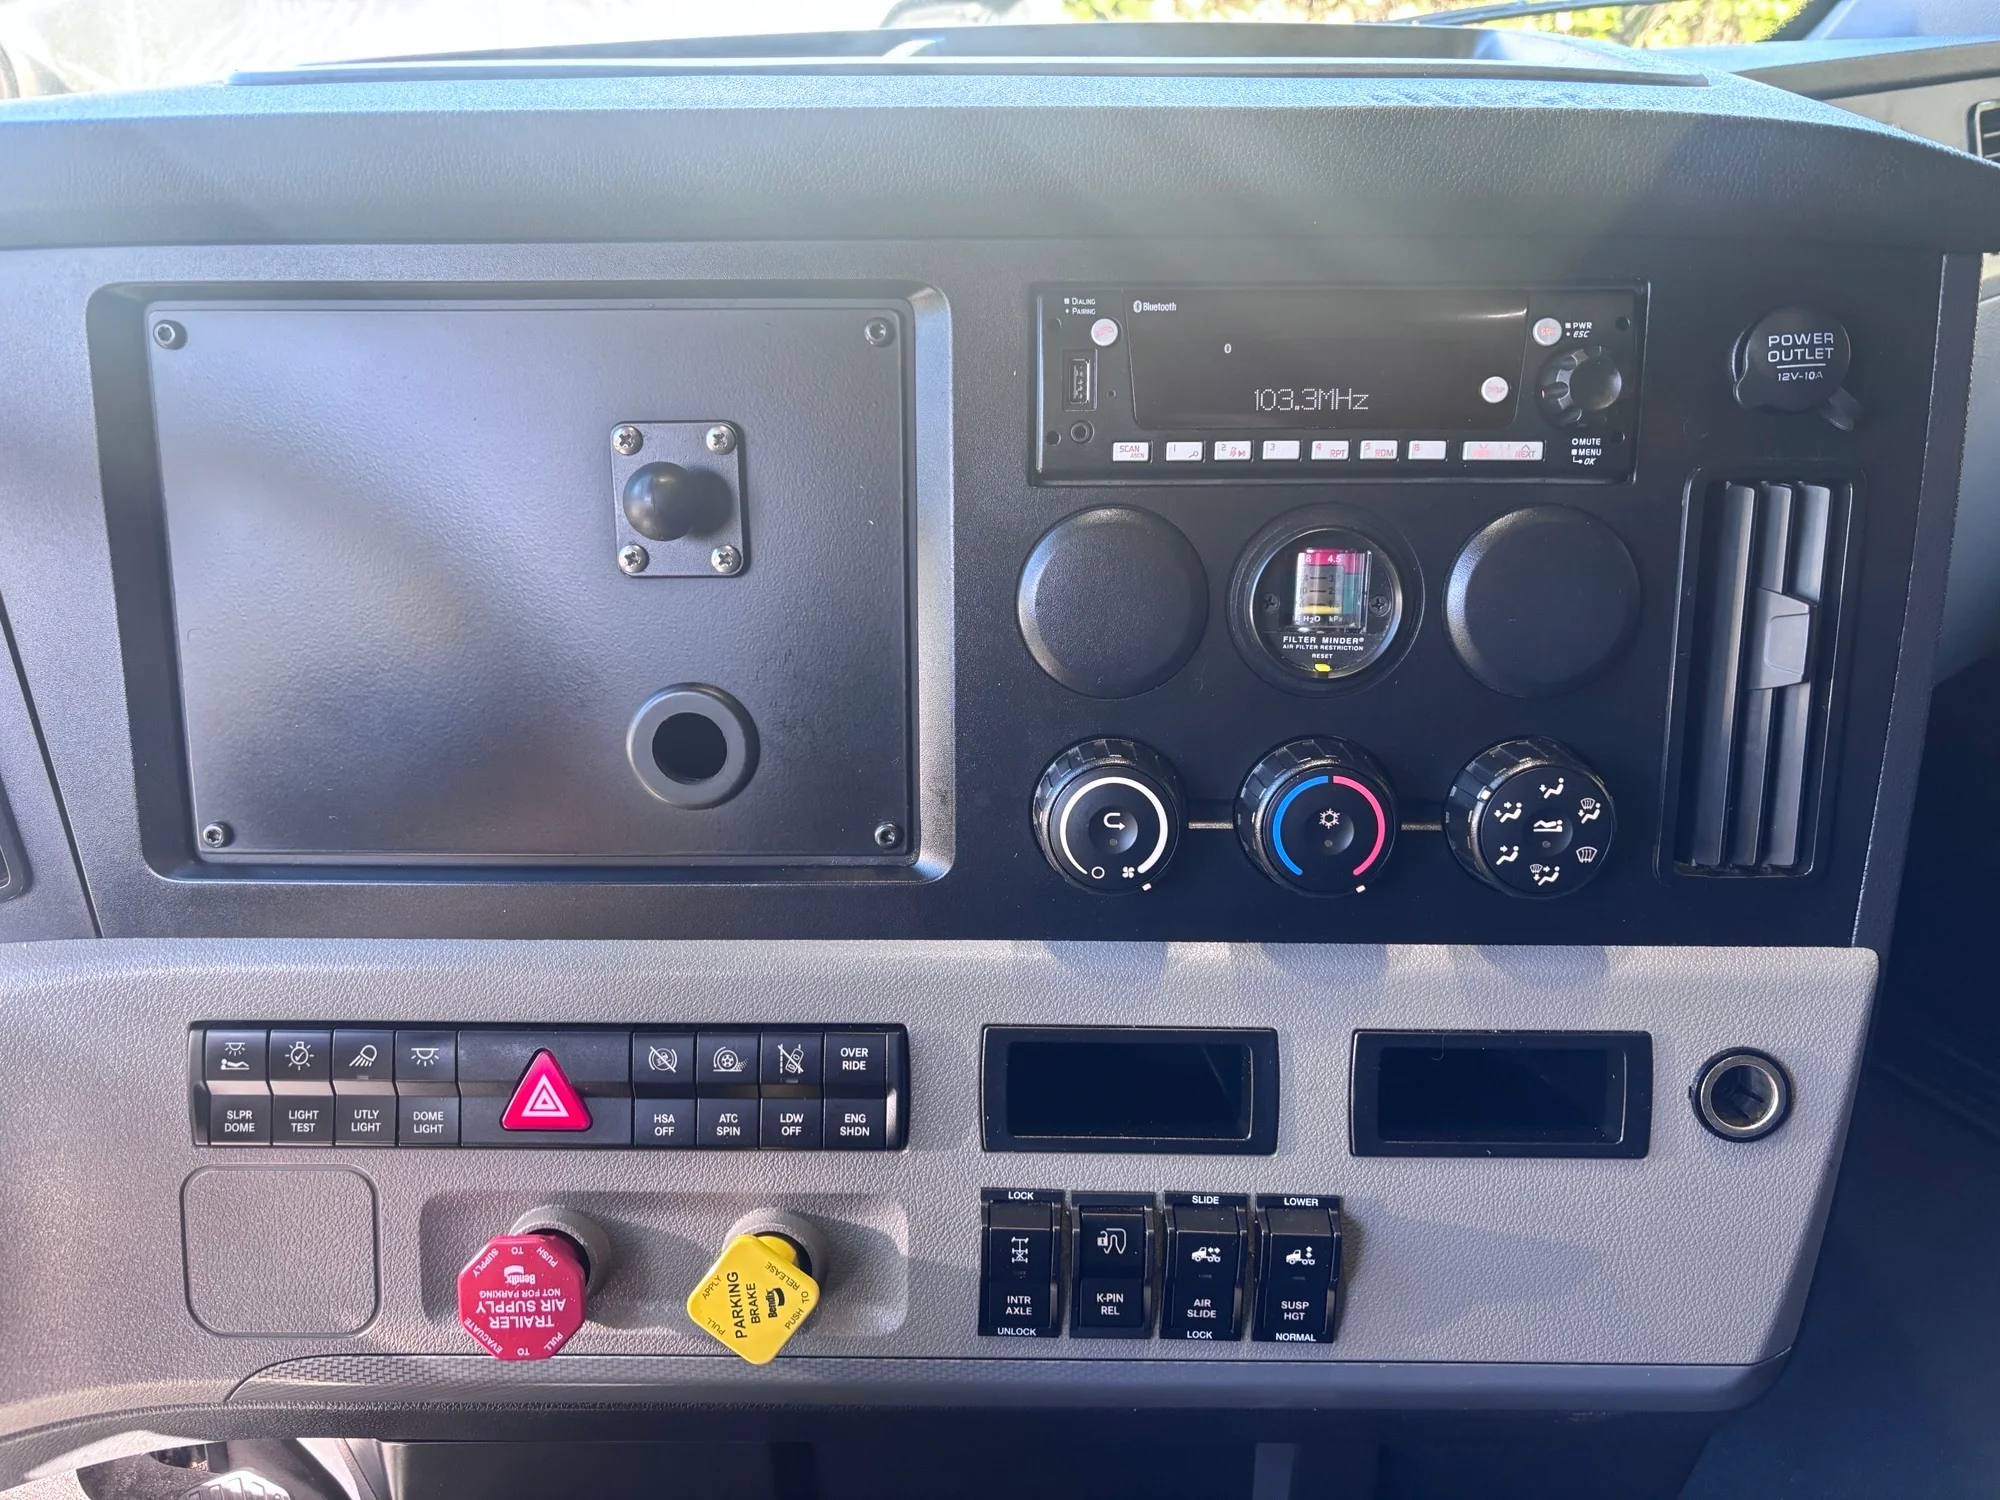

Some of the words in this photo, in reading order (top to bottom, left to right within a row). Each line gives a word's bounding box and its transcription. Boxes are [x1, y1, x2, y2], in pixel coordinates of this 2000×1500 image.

[1071, 297, 1096, 305] DIALING
[1072, 307, 1096, 315] PAIRING
[1143, 301, 1177, 312] Bluetooth
[1573, 330, 1590, 338] ESC
[1768, 332, 1835, 347] POWER
[1767, 347, 1835, 363] OUTLET
[1777, 371, 1824, 382] 12V-10A
[1254, 388, 1369, 411] 103.3MHz
[1270, 442, 1276, 451] 3
[1315, 442, 1322, 451] 4
[1579, 438, 1601, 446] MUTE
[1119, 445, 1140, 453] SCAN
[1221, 443, 1227, 452] 2
[1375, 448, 1394, 457] RDM
[1578, 448, 1602, 456] MENU
[1330, 449, 1346, 458] RPT
[1515, 450, 1536, 458] NEXT
[1583, 458, 1596, 466] OK
[1327, 554, 1342, 563] 4.5
[1283, 636, 1316, 644] FILTER
[840, 1047, 869, 1058] OVER
[842, 1060, 867, 1071] RIDE
[226, 1110, 253, 1120] SLPR
[288, 1110, 319, 1121] LIGHT
[353, 1109, 380, 1120] UTLY
[413, 1111, 444, 1121] DOME
[653, 1113, 675, 1124] HSA
[718, 1113, 739, 1124] ATC
[779, 1113, 804, 1124] LDW
[844, 1113, 867, 1124] ENG
[224, 1122, 255, 1133] DOME
[291, 1122, 316, 1133] TEST
[351, 1122, 382, 1132] LIGHT
[413, 1123, 444, 1134] LIGHT
[654, 1126, 675, 1137] OFF
[716, 1126, 741, 1136] SPIN
[781, 1126, 802, 1136] OFF
[839, 1126, 870, 1137] SHDN
[1008, 1191, 1034, 1200] LOCK
[1192, 1195, 1220, 1205] SLIDE
[1284, 1197, 1319, 1207] LOWER
[511, 1246, 524, 1255] TO
[536, 1246, 559, 1268] PUSH
[473, 1248, 499, 1278] SUPPLY
[505, 1273, 536, 1285] Bendix
[764, 1261, 800, 1291] RELEASE
[701, 1274, 723, 1300] APPLY
[479, 1289, 519, 1298] PARKING
[522, 1289, 540, 1297] FOR
[542, 1288, 561, 1297] NOT
[800, 1290, 810, 1304] TO
[745, 1282, 761, 1324] BRAKE
[1007, 1295, 1032, 1305] INTR
[1096, 1293, 1124, 1303] K-PIN
[1193, 1298, 1212, 1308] AIR
[475, 1300, 537, 1314] SUPPLY
[541, 1298, 567, 1312] AIR
[726, 1271, 748, 1339] PARKING
[765, 1288, 778, 1319] Bendix
[1281, 1300, 1310, 1310] SUSP
[1005, 1306, 1033, 1316] AXLE
[1100, 1305, 1120, 1316] REL
[1187, 1309, 1217, 1319] SLIDE
[489, 1314, 555, 1329] TRAILER
[784, 1307, 805, 1330] PUSH
[1283, 1312, 1306, 1321] HGT
[707, 1317, 726, 1336] PULL
[463, 1317, 504, 1355] EVACUATE
[997, 1327, 1037, 1337] UNLOCK
[1186, 1330, 1213, 1340] LOCK
[1275, 1332, 1317, 1342] NORMAL
[543, 1331, 564, 1351] PULL
[517, 1347, 530, 1356] TO
